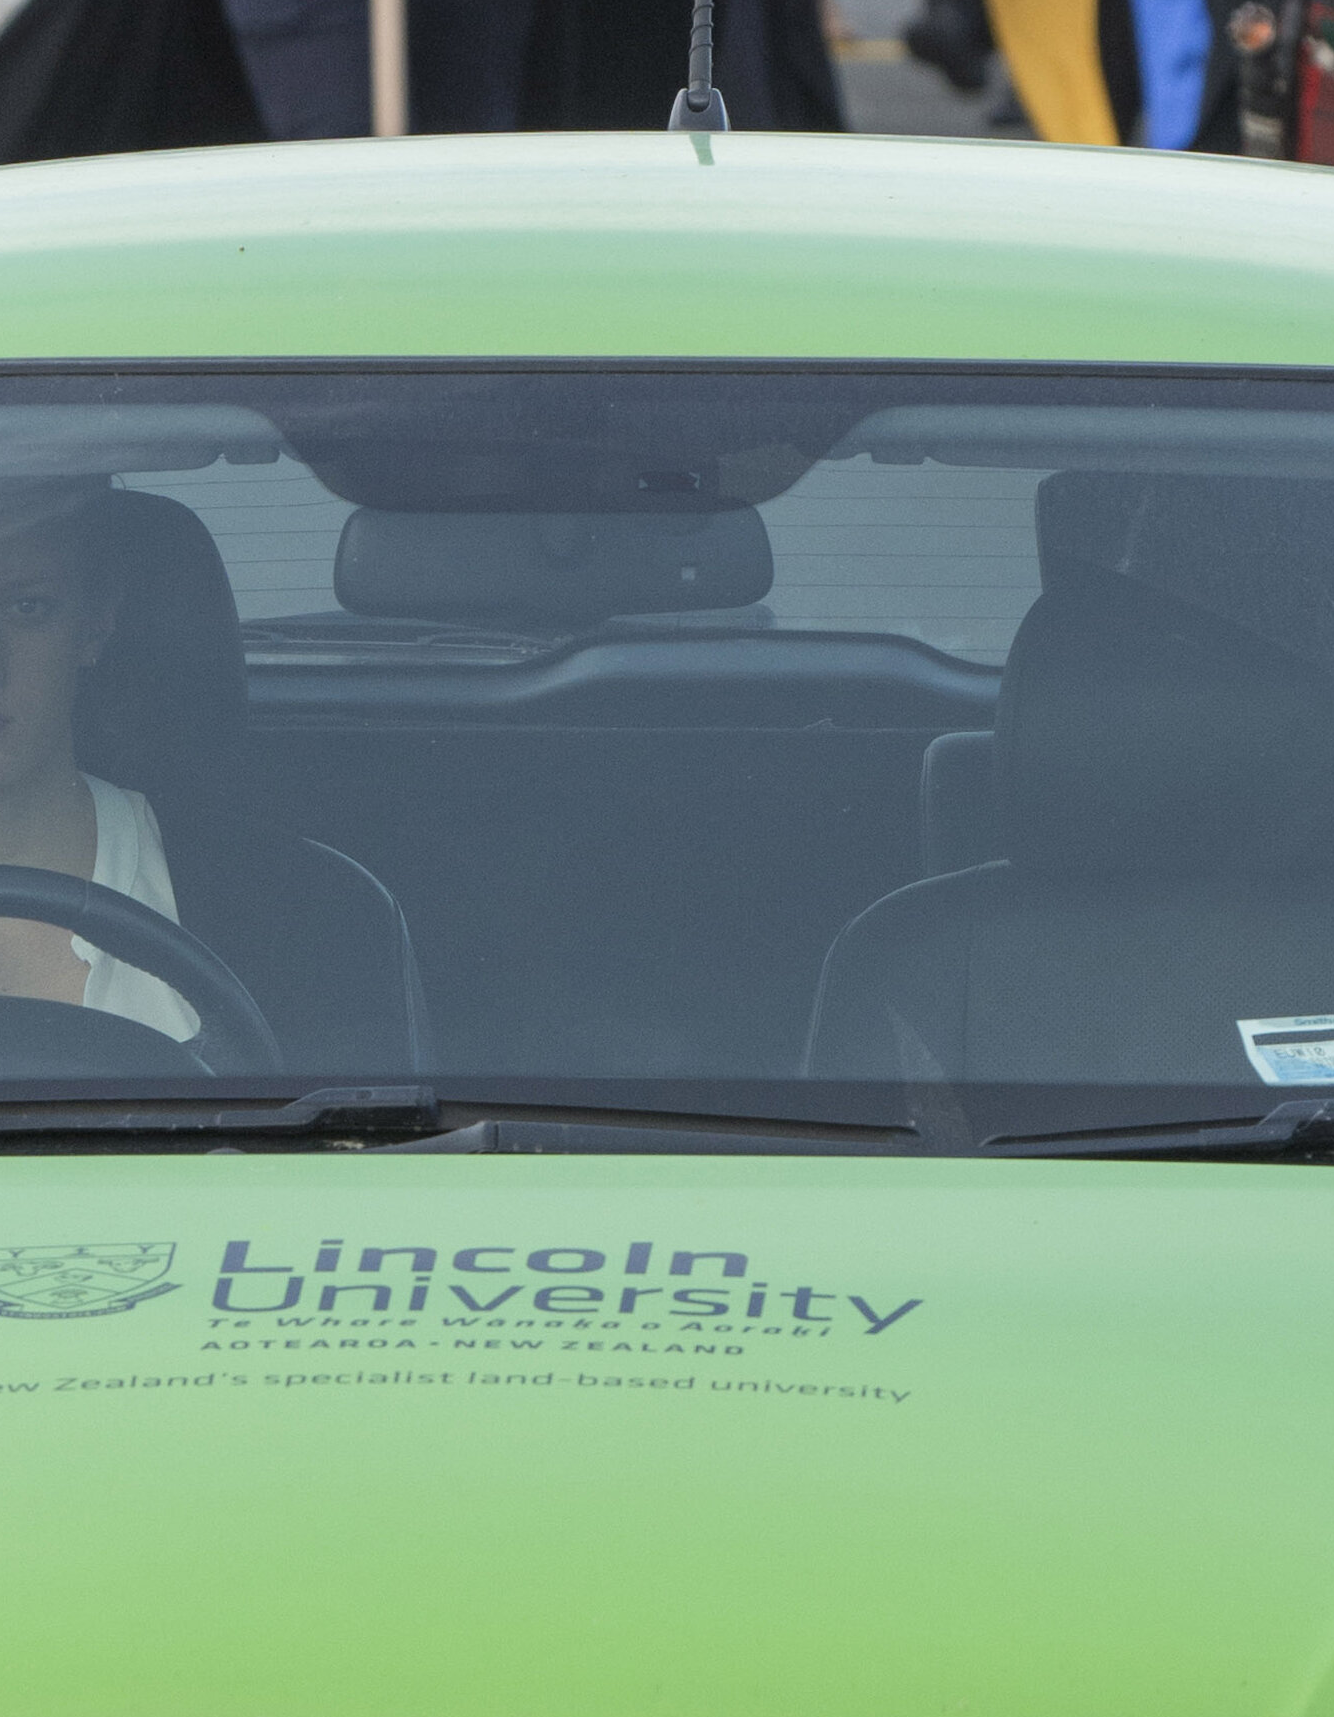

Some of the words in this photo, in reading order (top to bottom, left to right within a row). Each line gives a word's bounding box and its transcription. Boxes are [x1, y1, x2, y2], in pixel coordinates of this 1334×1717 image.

[219, 1238, 750, 1277] Lincoln
[210, 1275, 925, 1335] University
[208, 1317, 253, 1328] Te
[276, 1315, 419, 1328] Whare
[641, 1321, 662, 1331] o
[679, 1319, 834, 1337] Aoraki
[200, 1337, 417, 1351] AOTEAROA
[453, 1338, 544, 1350] NEW
[559, 1340, 746, 1355] ZEALAND
[53, 1370, 249, 1392] Zealand's
[264, 1369, 456, 1389] specialist
[466, 1371, 697, 1391] land-based
[709, 1378, 913, 1405] university
